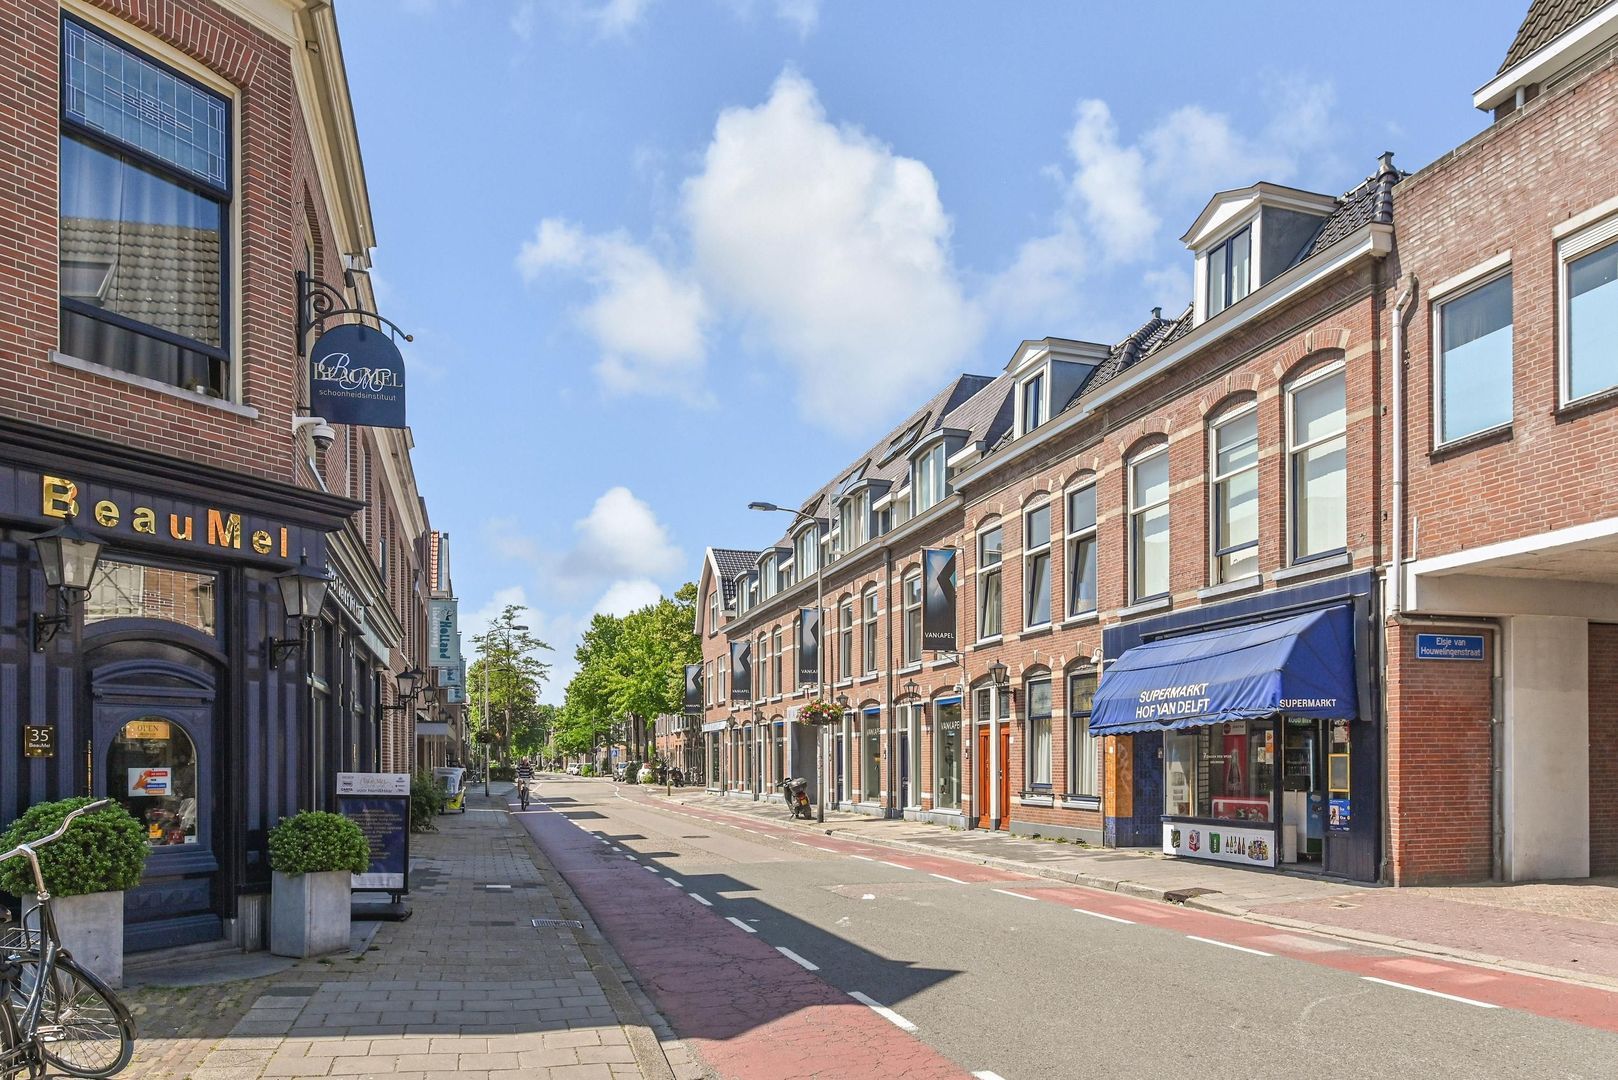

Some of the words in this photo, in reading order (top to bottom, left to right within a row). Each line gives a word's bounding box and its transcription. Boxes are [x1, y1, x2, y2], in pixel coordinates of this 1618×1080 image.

[319, 388, 396, 402] schoonheidsinstituut
[42, 474, 288, 557] BeauMel
[439, 620, 453, 659] Holland
[1436, 637, 1452, 649] Elsje
[1420, 646, 1481, 658] Houwelingenstraat
[1139, 682, 1209, 703] SUPERMARKT
[1135, 703, 1156, 719] HOF
[1157, 700, 1178, 717] VAN
[1177, 697, 1210, 715] DELFT
[1279, 698, 1337, 708] SUPERMARKT
[30, 729, 49, 742] 35
